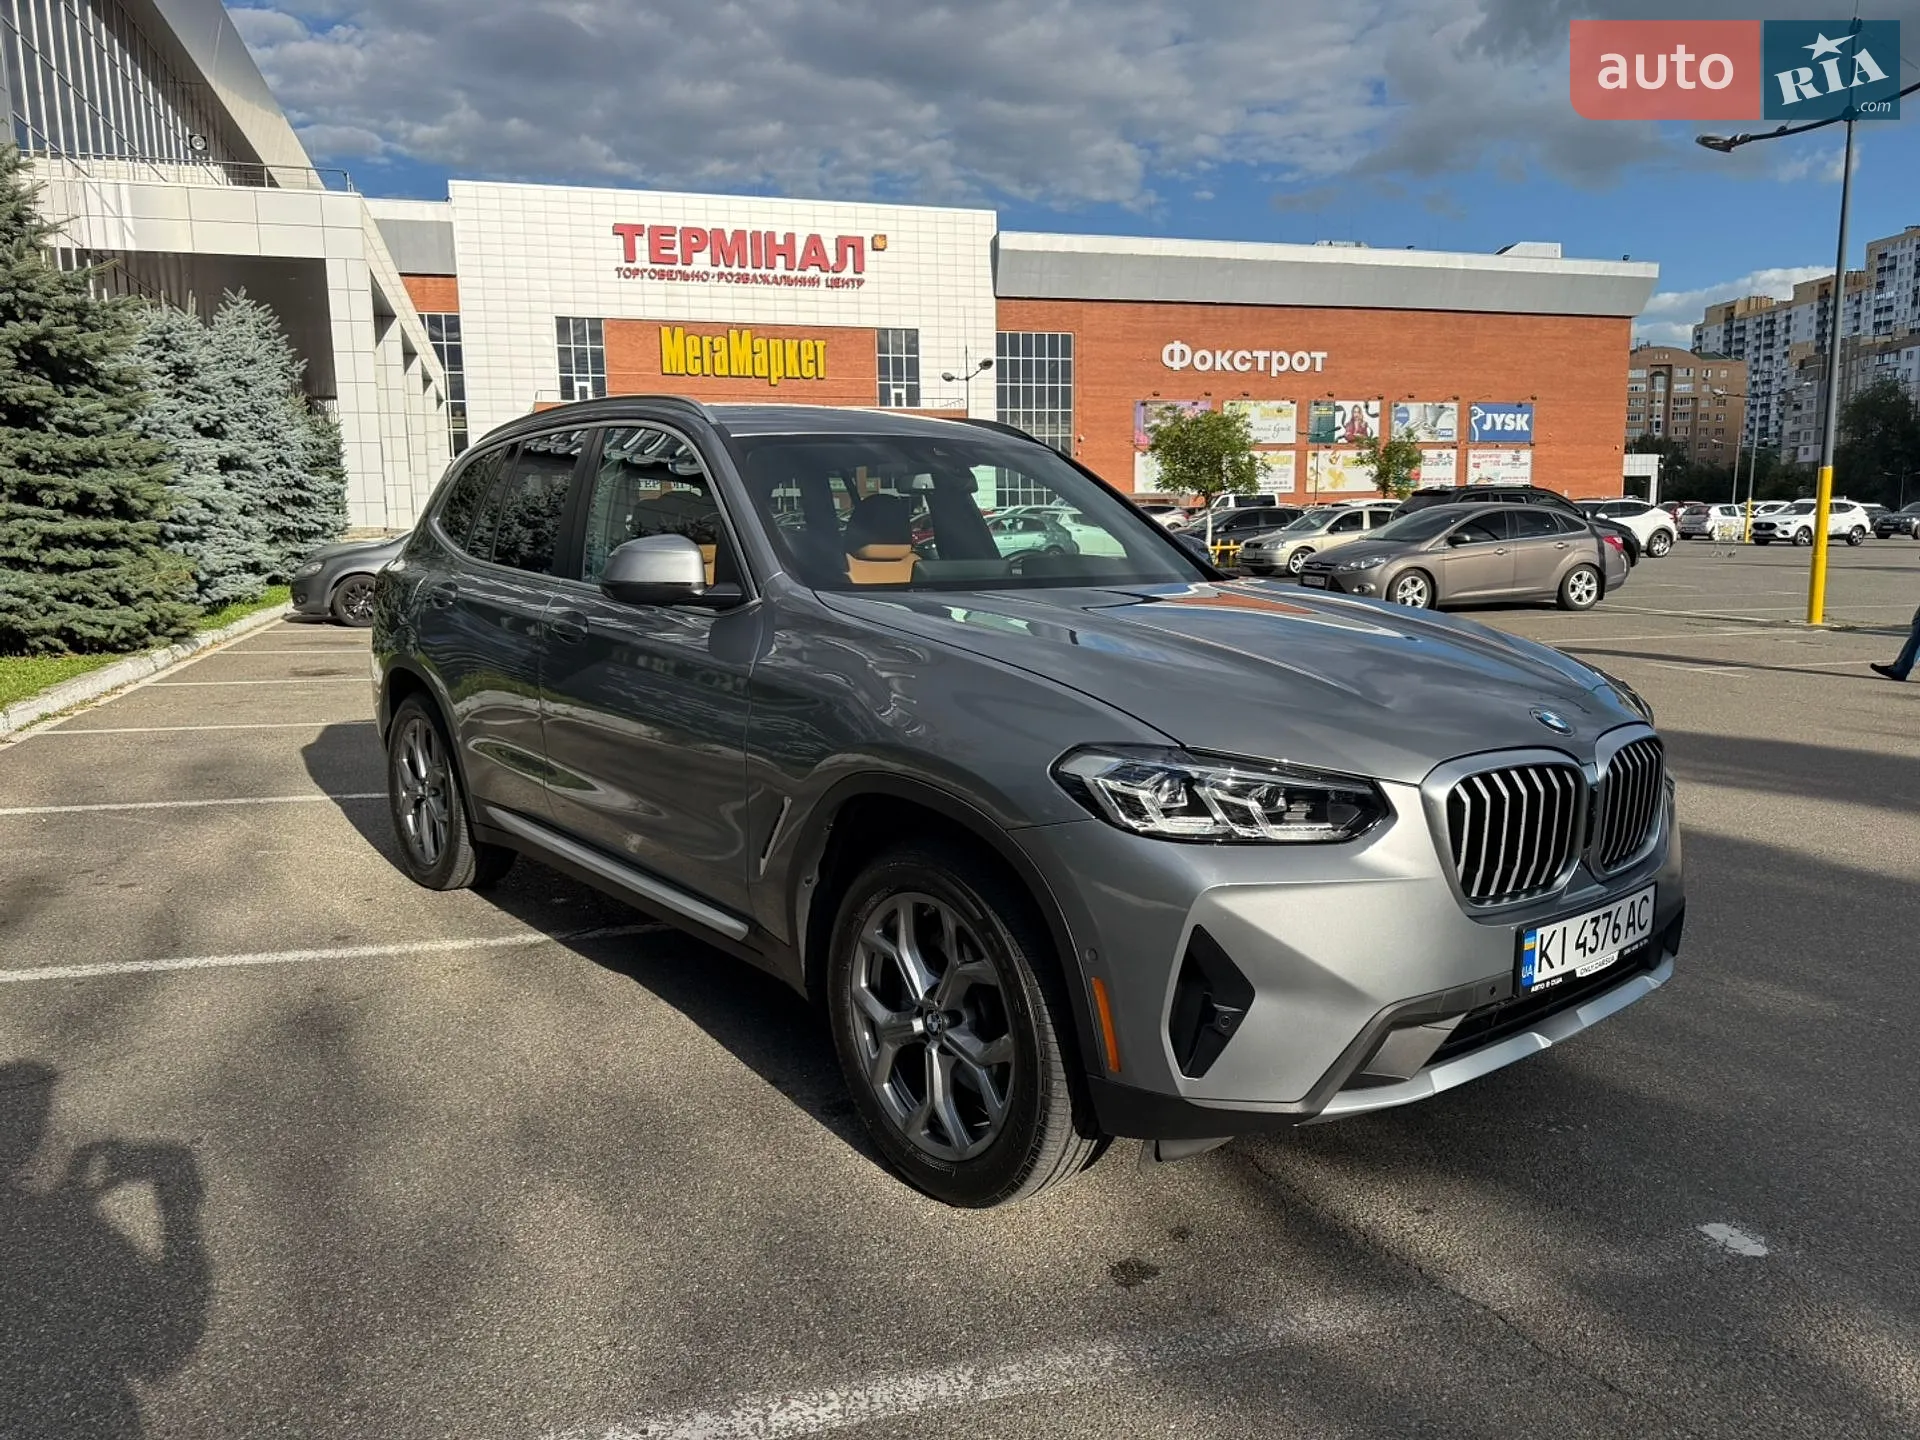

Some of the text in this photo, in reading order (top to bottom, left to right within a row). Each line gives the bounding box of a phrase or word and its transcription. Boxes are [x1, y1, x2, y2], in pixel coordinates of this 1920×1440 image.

[612, 223, 865, 274] ТЕРМІНАЛ
[825, 277, 865, 290] ЦЕНТР
[660, 326, 827, 386] МегаМаркет
[1161, 341, 1328, 377] Фокстрот
[1482, 413, 1530, 431] JYSK
[1538, 895, 1649, 973] KI 4376 AC
[1522, 964, 1533, 978] UA
